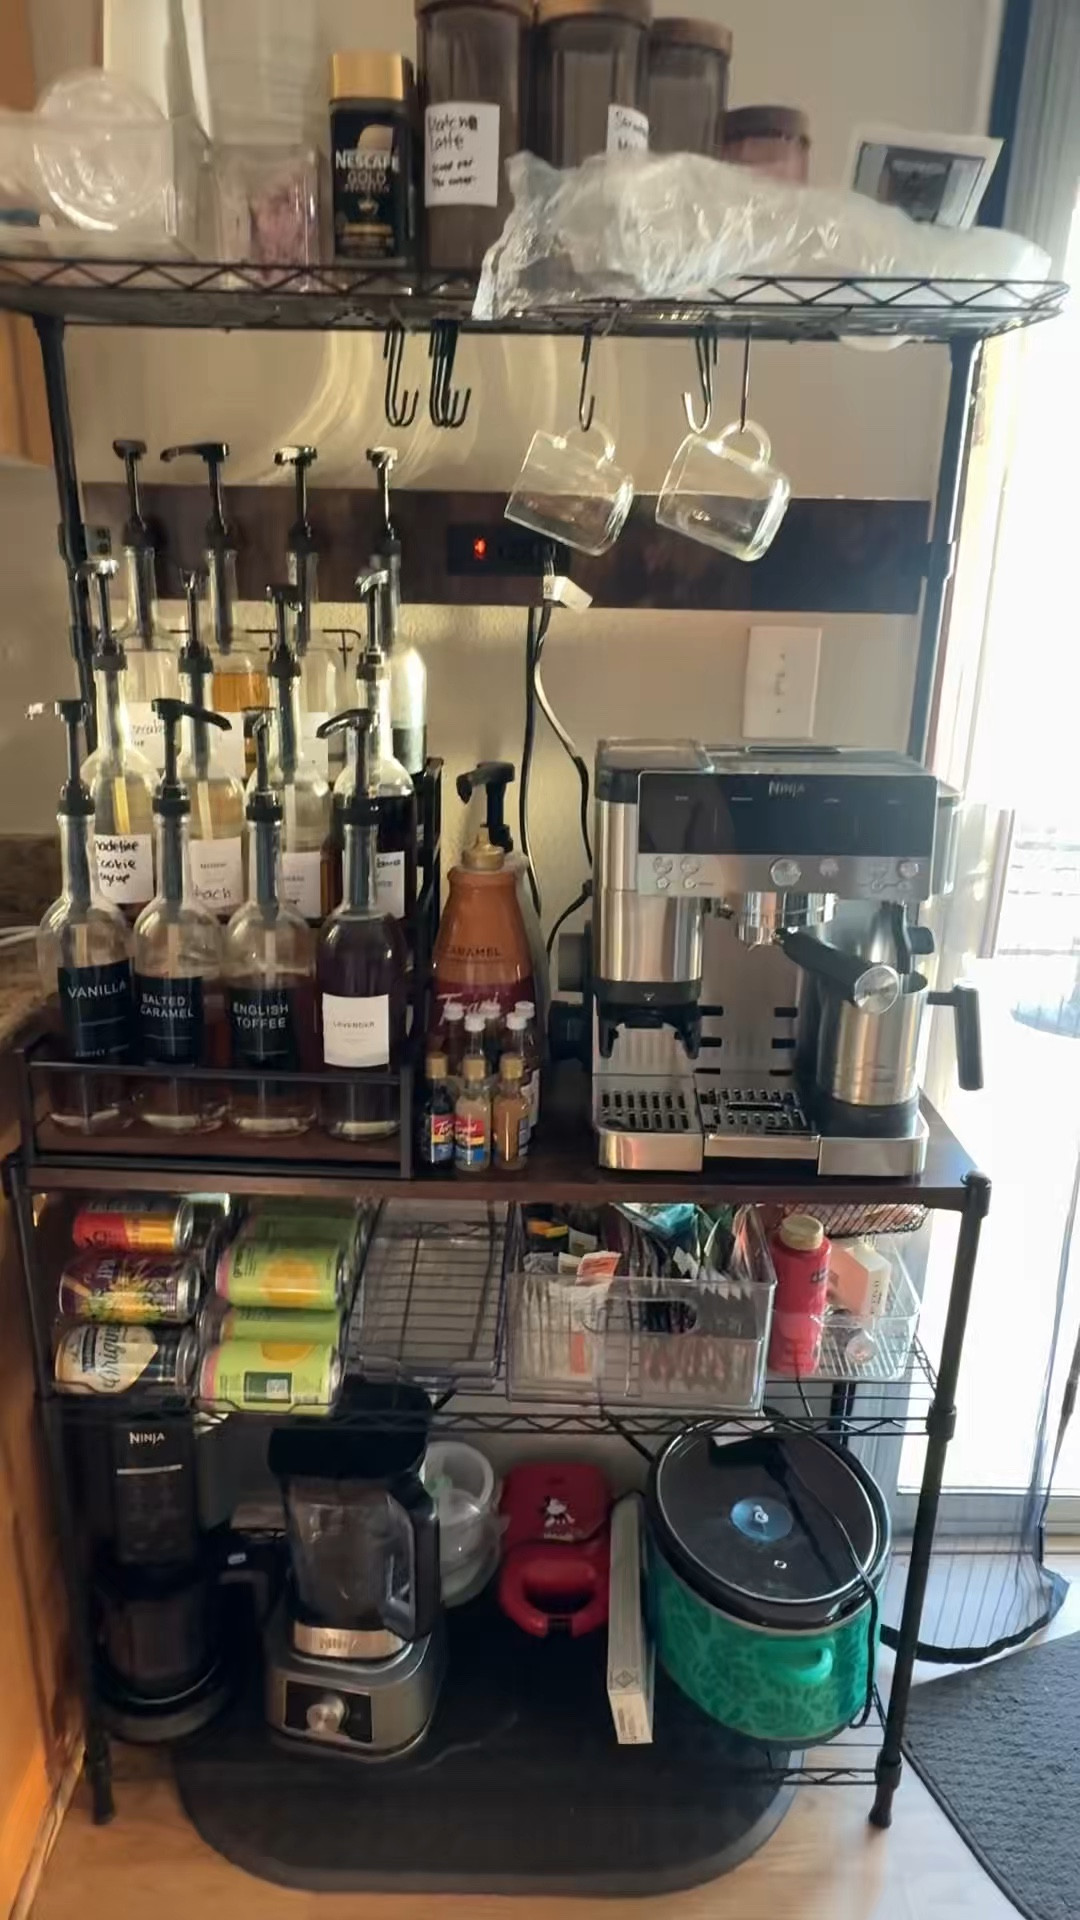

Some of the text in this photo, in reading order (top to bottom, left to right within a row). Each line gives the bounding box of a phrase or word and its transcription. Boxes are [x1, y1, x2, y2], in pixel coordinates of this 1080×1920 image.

[67, 980, 127, 999] VANILLA
[142, 993, 186, 1007] SALTED
[140, 1004, 194, 1018] CARAMEL
[233, 1001, 289, 1016] ENGLISH
[236, 1016, 287, 1030] TOFFEE
[129, 1431, 166, 1445] NINJA
